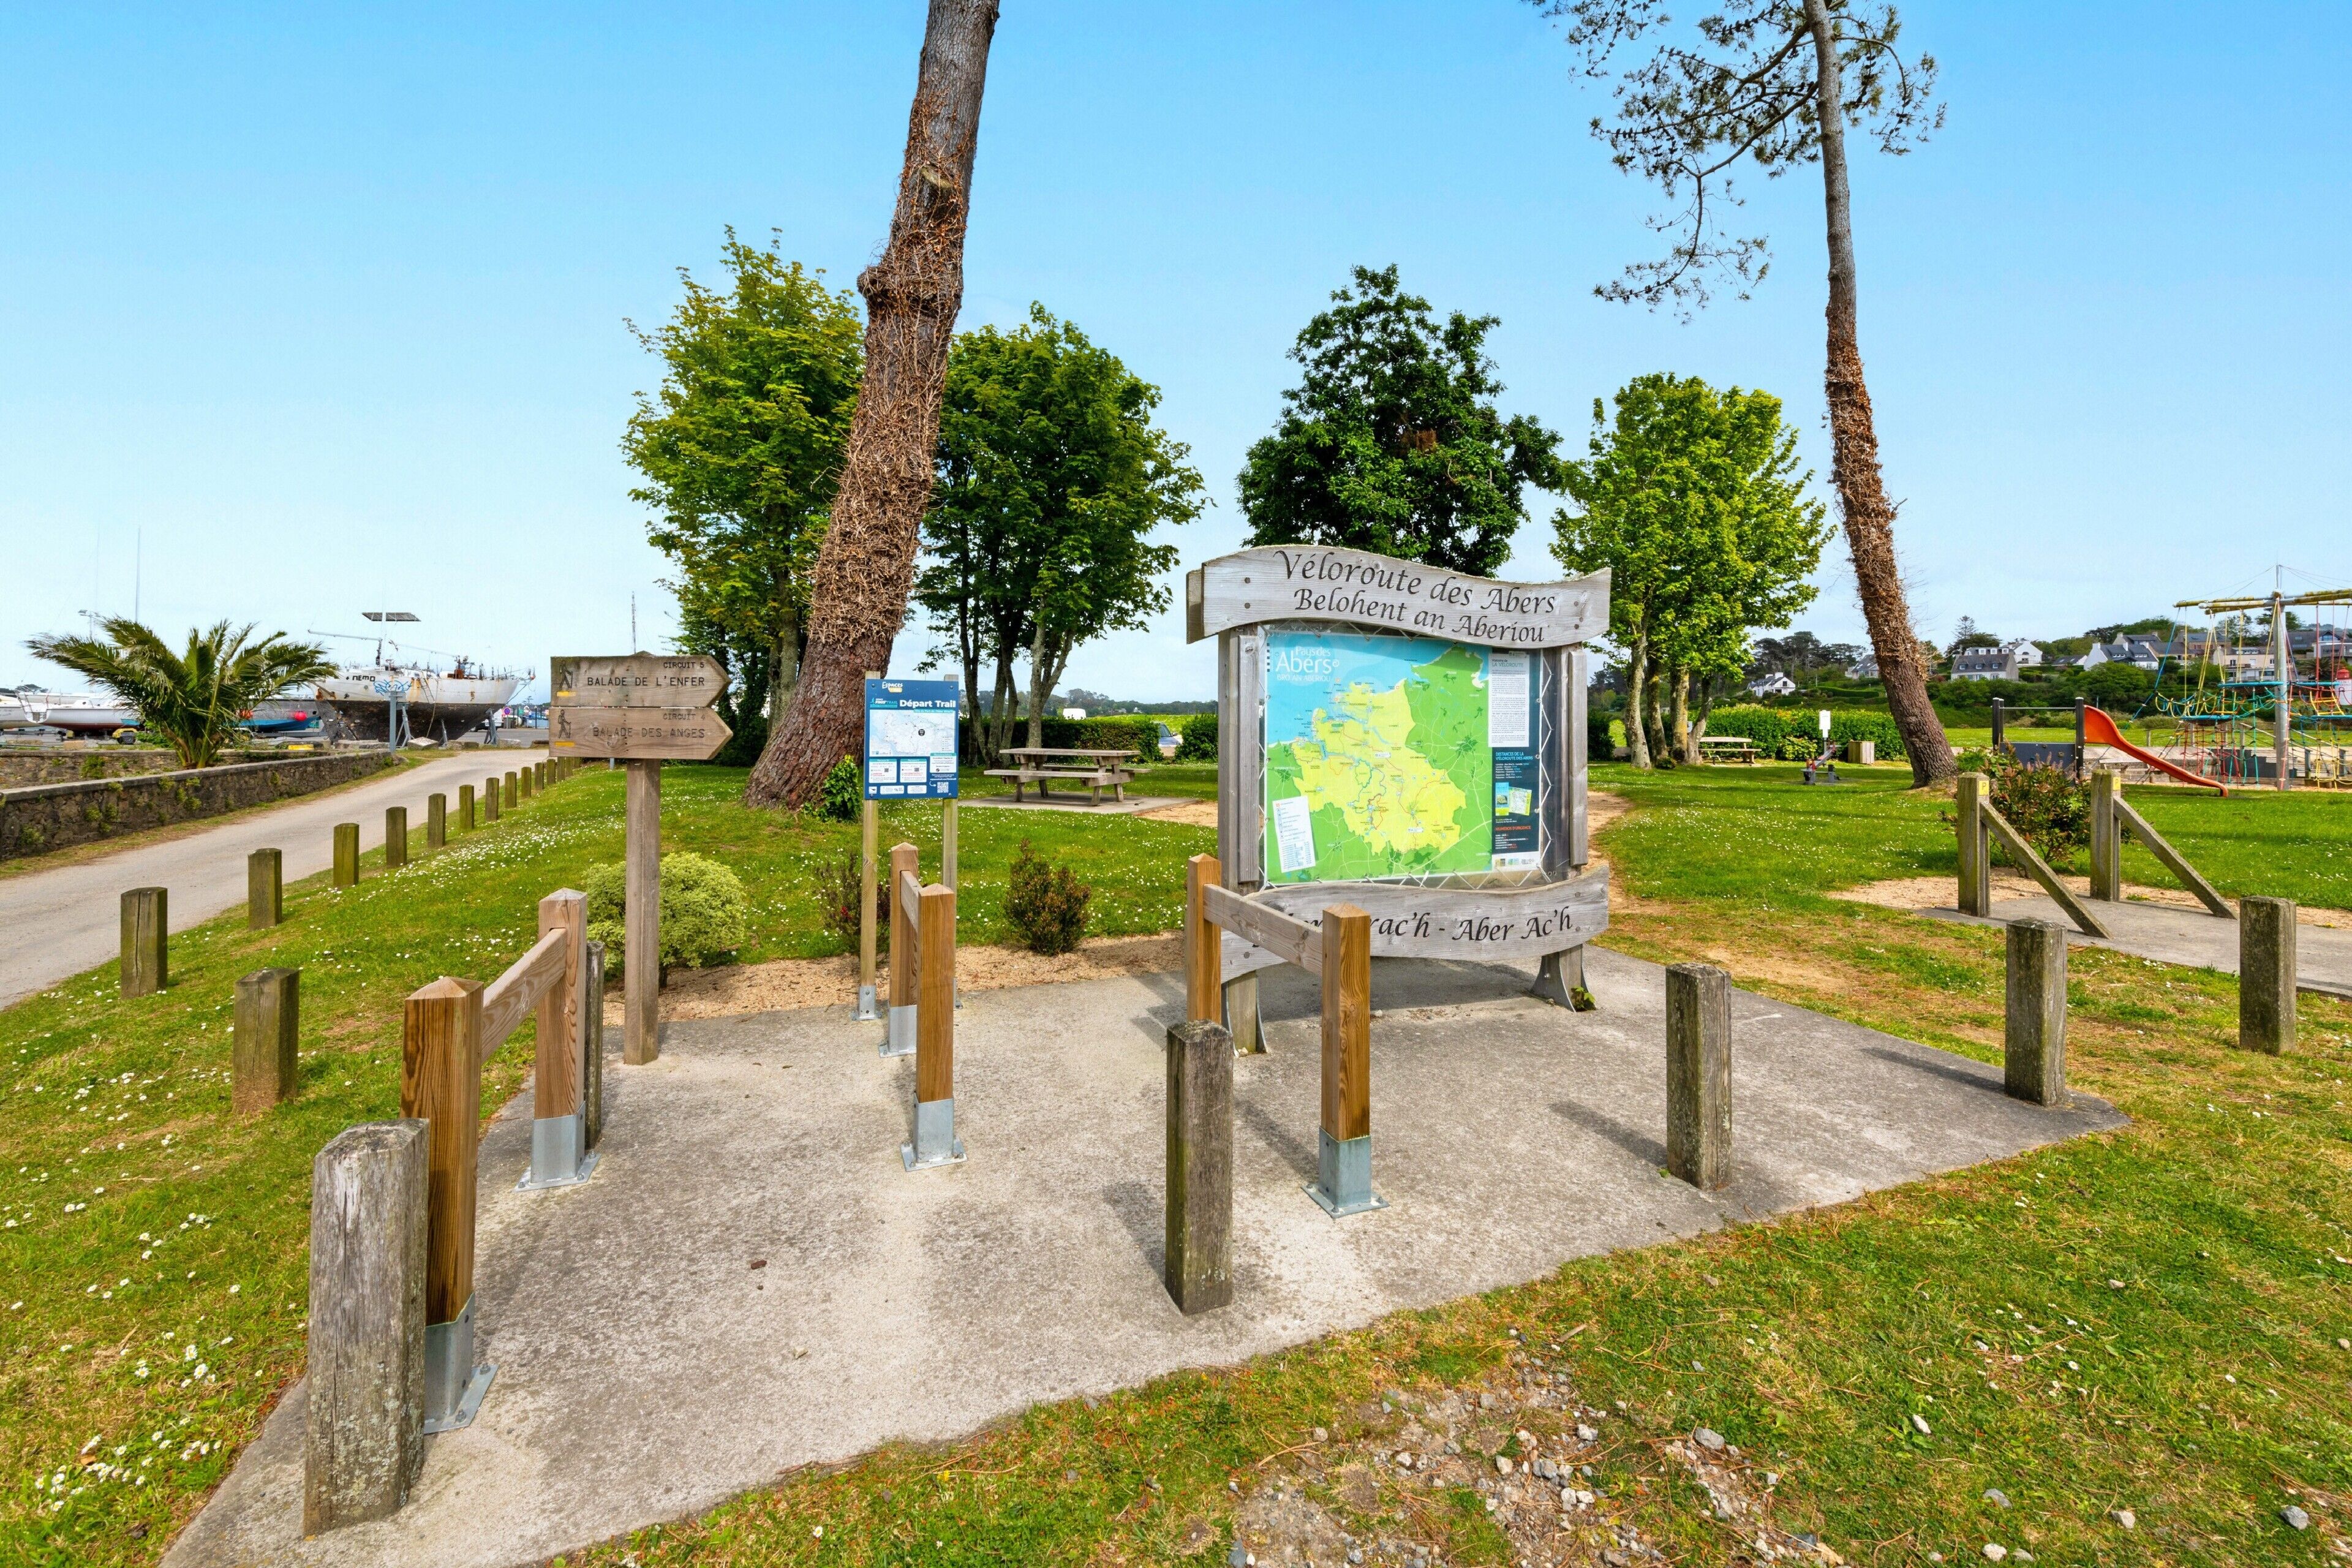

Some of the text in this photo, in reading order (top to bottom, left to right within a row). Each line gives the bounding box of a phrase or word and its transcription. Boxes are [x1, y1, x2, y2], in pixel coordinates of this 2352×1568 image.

[1273, 551, 1555, 614] Véloroute des Abers
[1294, 587, 1547, 643] Belohent an Aberiou
[1295, 646, 1331, 658] Pays des
[1276, 650, 1332, 674] Abers
[587, 676, 705, 686] BALADE DE L'ENFER
[882, 682, 903, 691] Espaces
[900, 699, 932, 708] Départ
[592, 727, 705, 738] BALADE DES ANGES
[1370, 912, 1431, 938] rac'h
[1452, 918, 1514, 941] Aber
[1521, 906, 1573, 939] Ac'h
